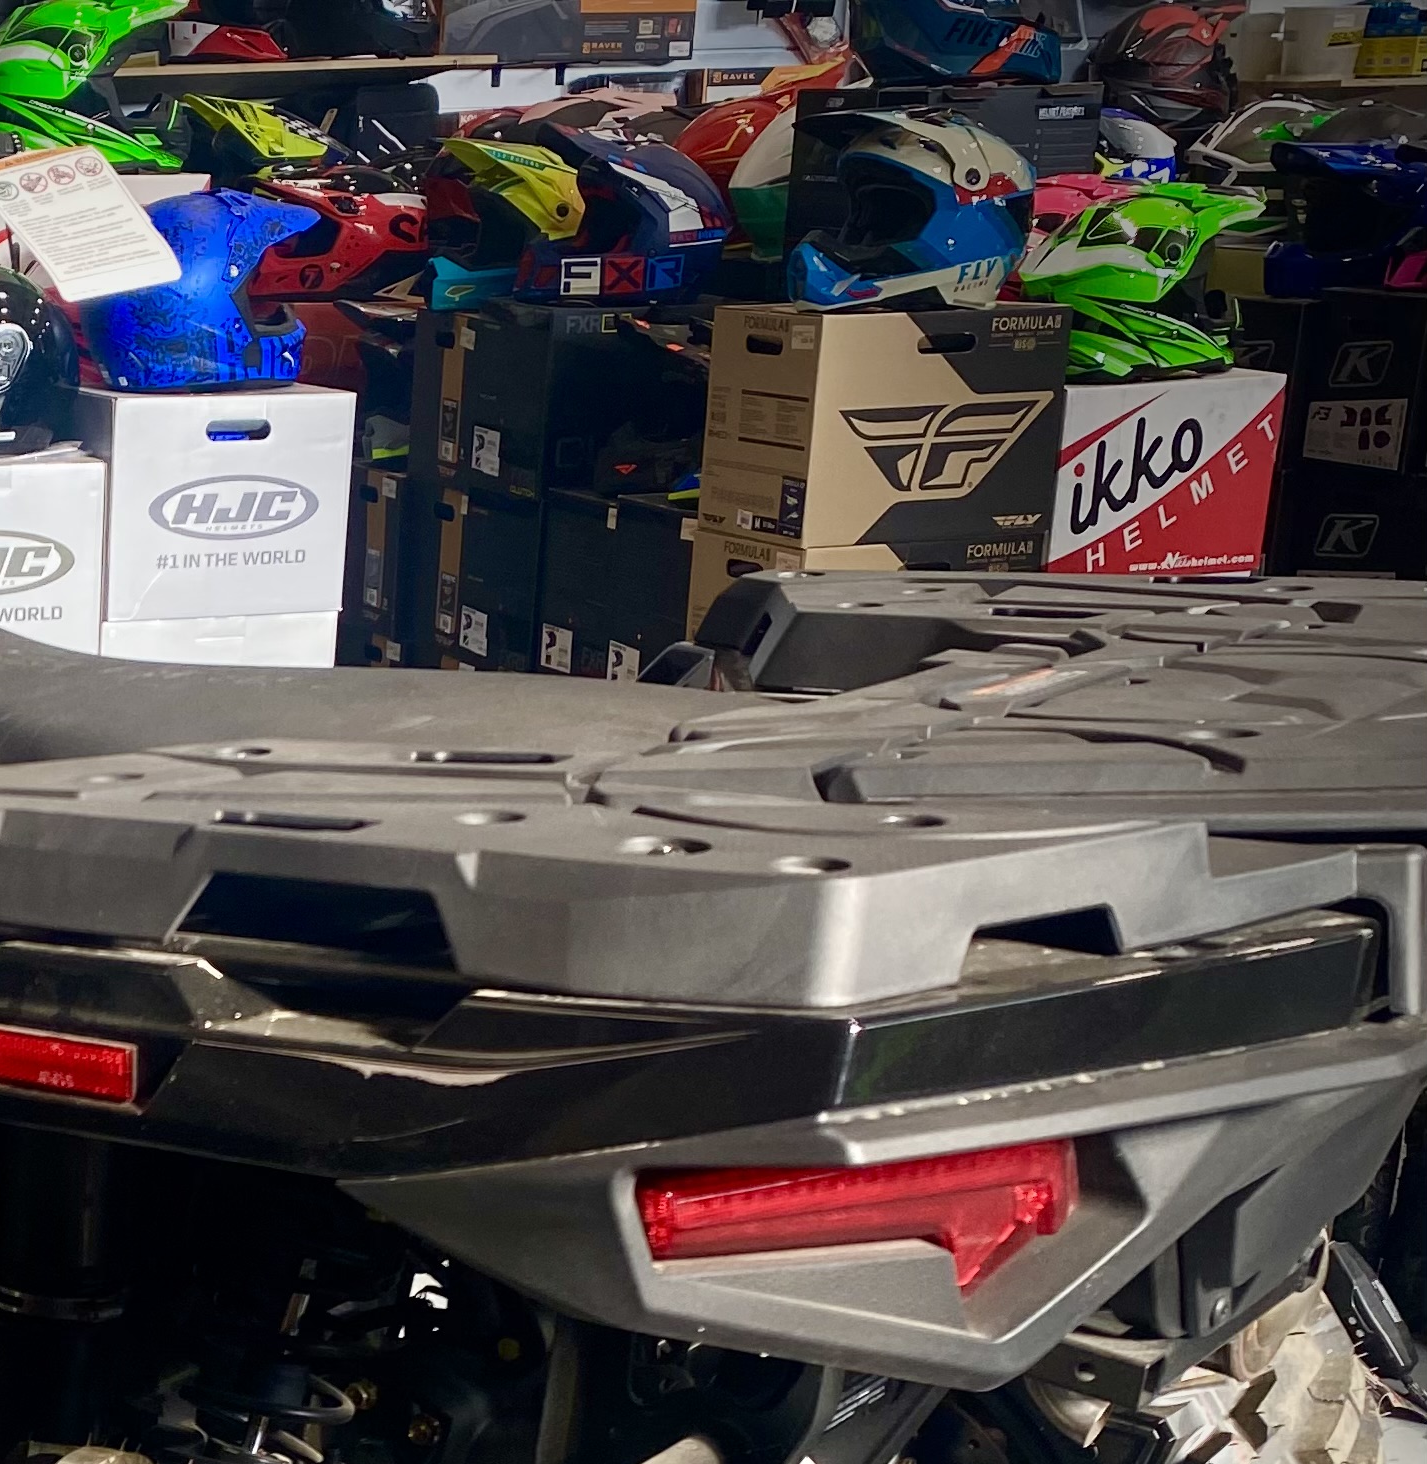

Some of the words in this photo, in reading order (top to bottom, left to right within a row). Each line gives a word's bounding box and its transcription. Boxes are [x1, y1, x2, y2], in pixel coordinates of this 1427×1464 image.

[957, 258, 998, 285] FLY
[991, 315, 1055, 332] FORMULA
[1086, 413, 1275, 573] HELMET
[171, 490, 299, 525] HJC
[205, 523, 264, 532] HELMETS
[156, 554, 180, 570] #1
[183, 553, 201, 568] IN
[204, 551, 239, 568] THE
[243, 549, 307, 566] WORLD
[967, 541, 1026, 558] FORMULA
